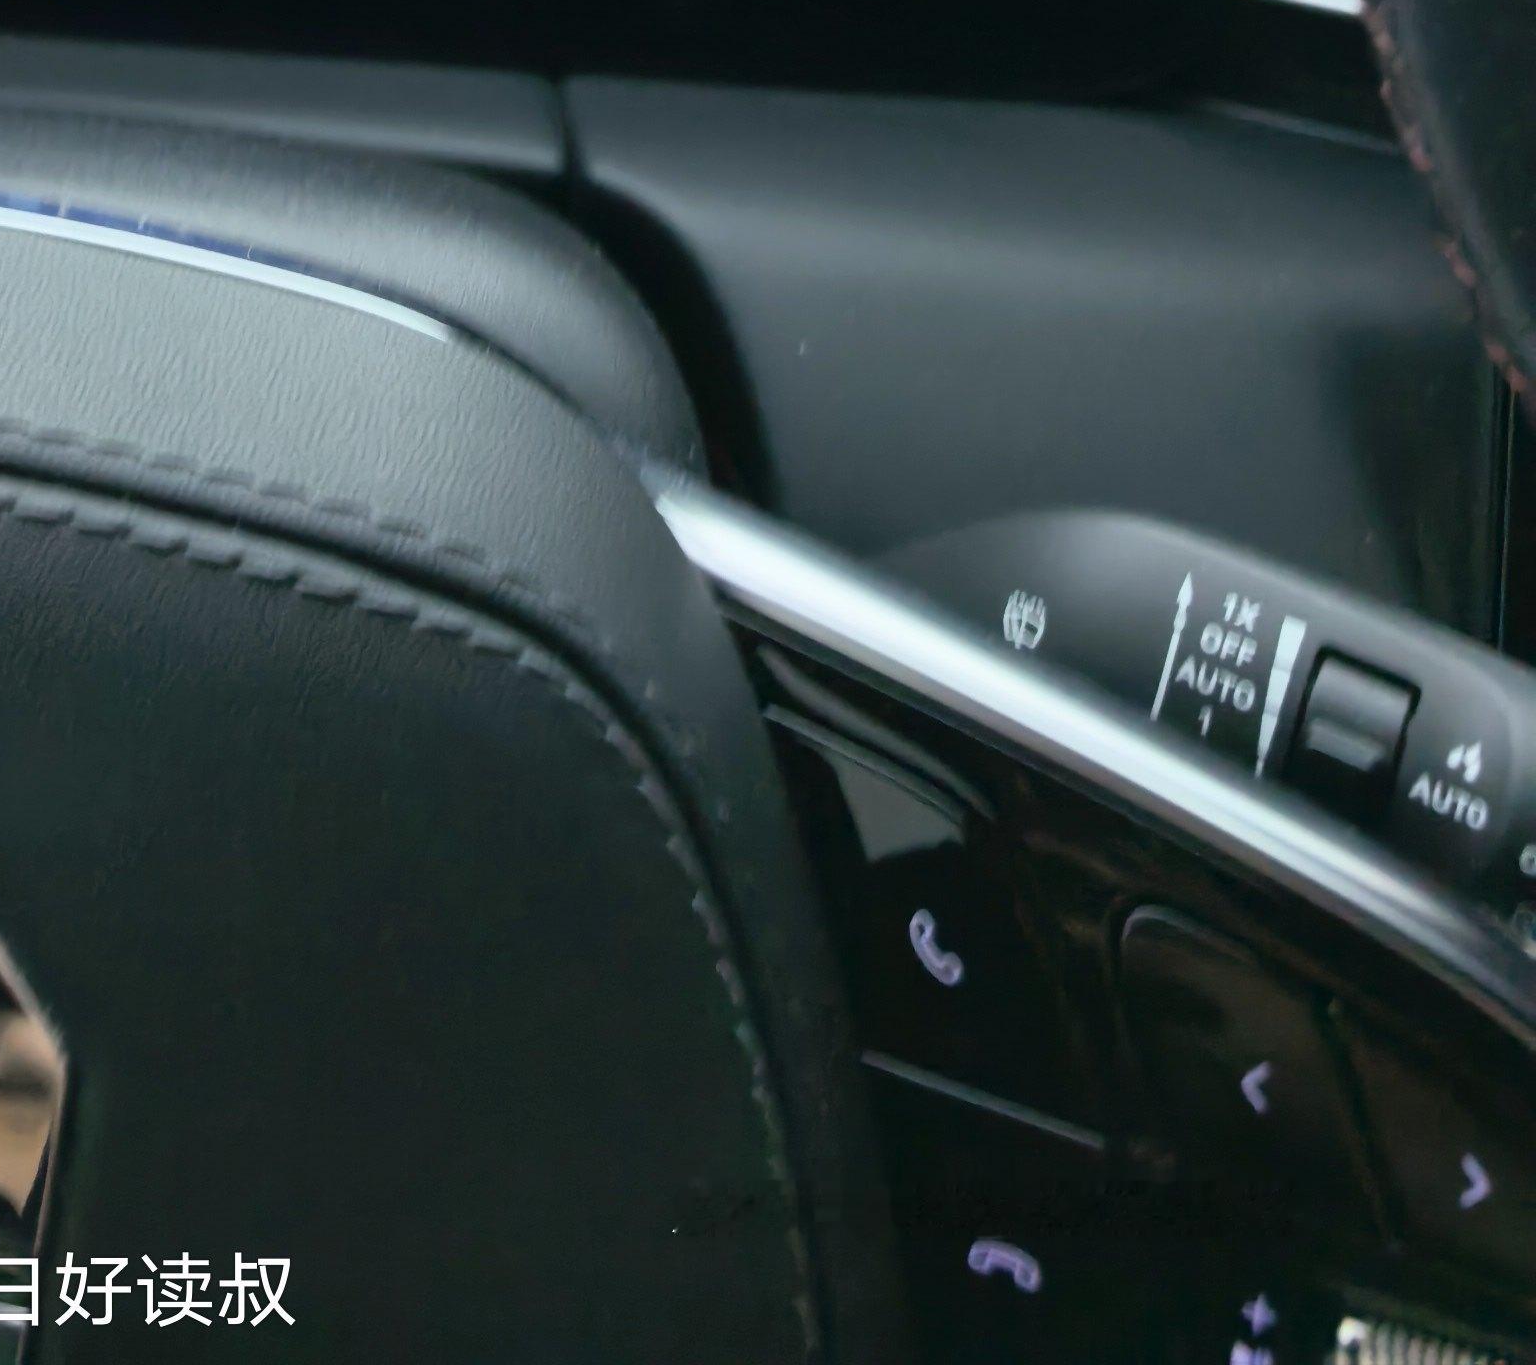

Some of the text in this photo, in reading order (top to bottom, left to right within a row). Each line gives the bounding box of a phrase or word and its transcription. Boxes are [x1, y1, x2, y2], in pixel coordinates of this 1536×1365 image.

[1199, 623, 1259, 667] OFF
[1174, 655, 1257, 713] AUTO
[1407, 771, 1491, 833] AUTO
